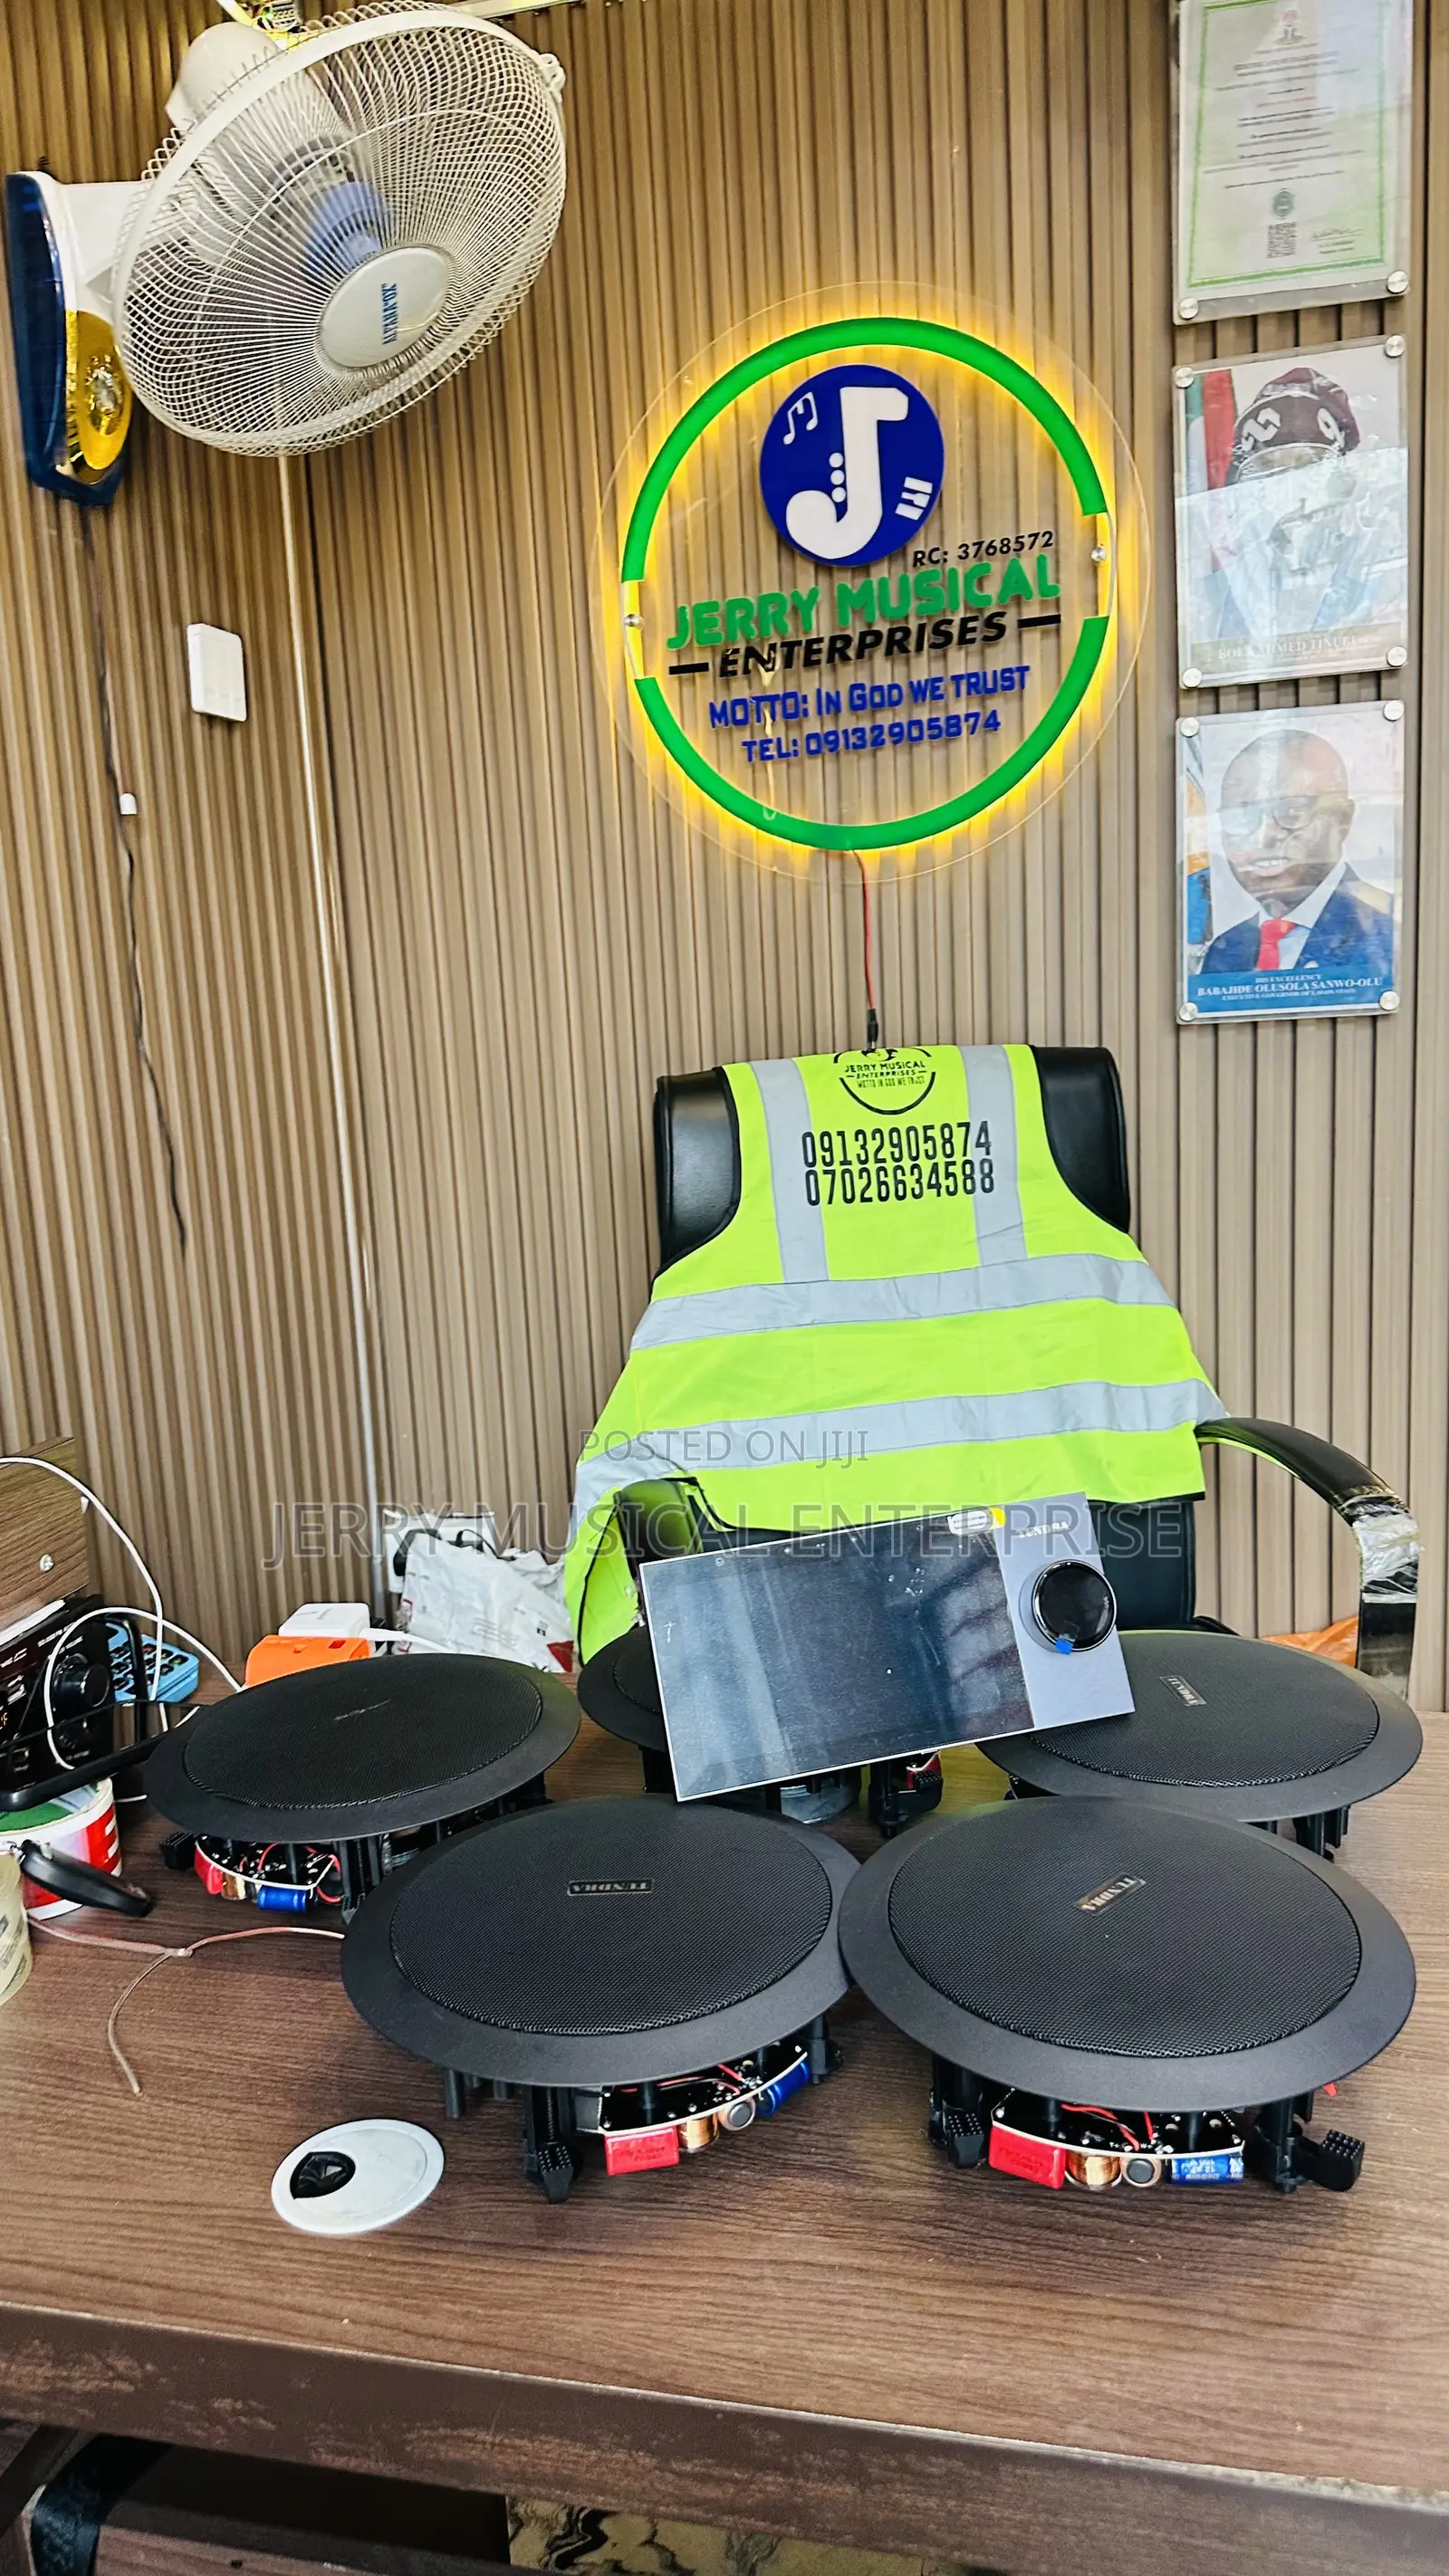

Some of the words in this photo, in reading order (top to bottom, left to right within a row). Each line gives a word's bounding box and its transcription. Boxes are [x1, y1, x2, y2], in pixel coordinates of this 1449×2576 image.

[912, 546, 949, 568] RC:
[956, 530, 1054, 561] 3768572
[666, 586, 820, 651] JERRY
[836, 553, 1062, 627] MUSICAL
[719, 611, 1008, 678] ENTERPRISES
[708, 691, 810, 729] MOTTO:
[950, 665, 1031, 699] TRUST
[741, 737, 800, 763] TEL:
[804, 709, 1002, 756] 09132905874
[1197, 984, 1253, 997] BABAJIDE
[1254, 982, 1310, 994] OLUSOLA
[1311, 977, 1383, 990] SANWO-OLU
[844, 1063, 877, 1073] JERRY
[879, 1060, 926, 1070] MUSICAL
[856, 1069, 916, 1079] ENTERPRISES
[801, 1120, 993, 1168] 09132905874
[805, 1157, 994, 1207] 07026634588
